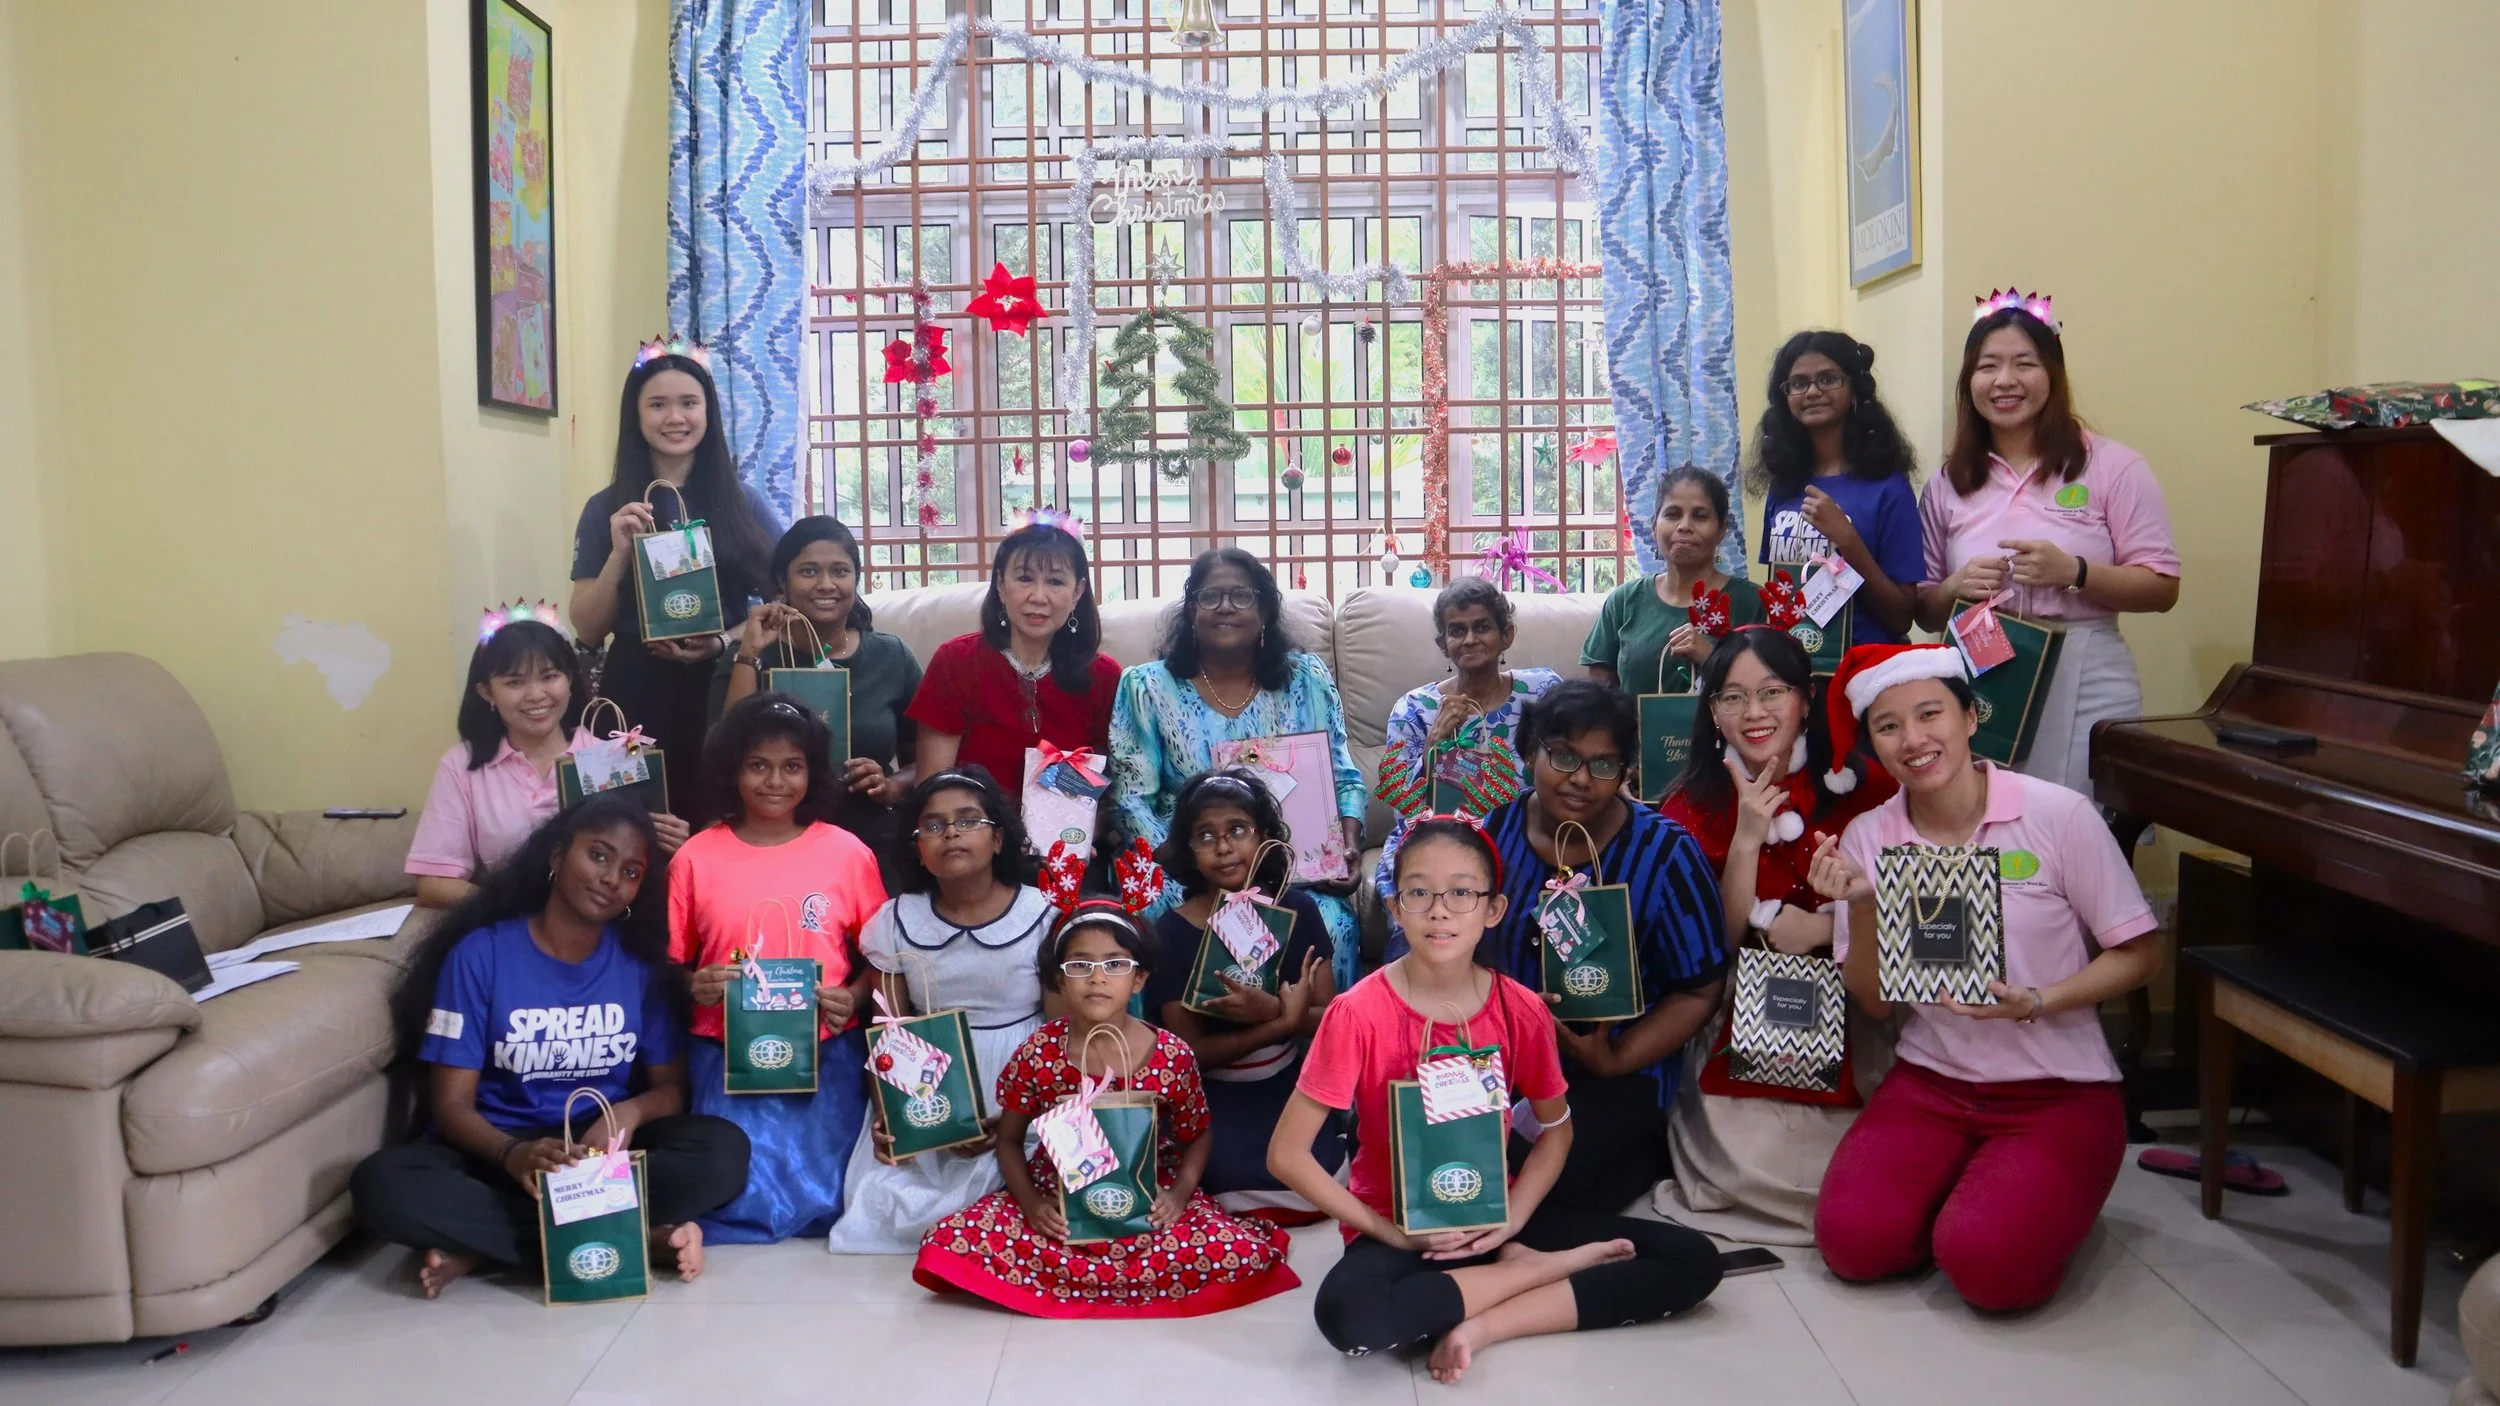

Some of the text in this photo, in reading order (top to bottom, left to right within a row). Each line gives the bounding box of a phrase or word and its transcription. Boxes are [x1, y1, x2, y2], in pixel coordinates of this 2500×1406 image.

[1101, 161, 1199, 197] Merry
[1088, 191, 1226, 228] Christmas
[1855, 208, 1905, 256] MOLOKINI
[1918, 922, 1957, 932] Especially
[1924, 931, 1952, 940] for you
[1773, 995, 1808, 1005] Especially
[1788, 1003, 1802, 1011] you
[506, 1003, 625, 1043] SPREAD
[494, 1031, 638, 1074] KINDNESS
[531, 1069, 573, 1081] HUMANITY
[553, 1181, 584, 1194] MERRY
[555, 1186, 606, 1204] CHRISTMAS
